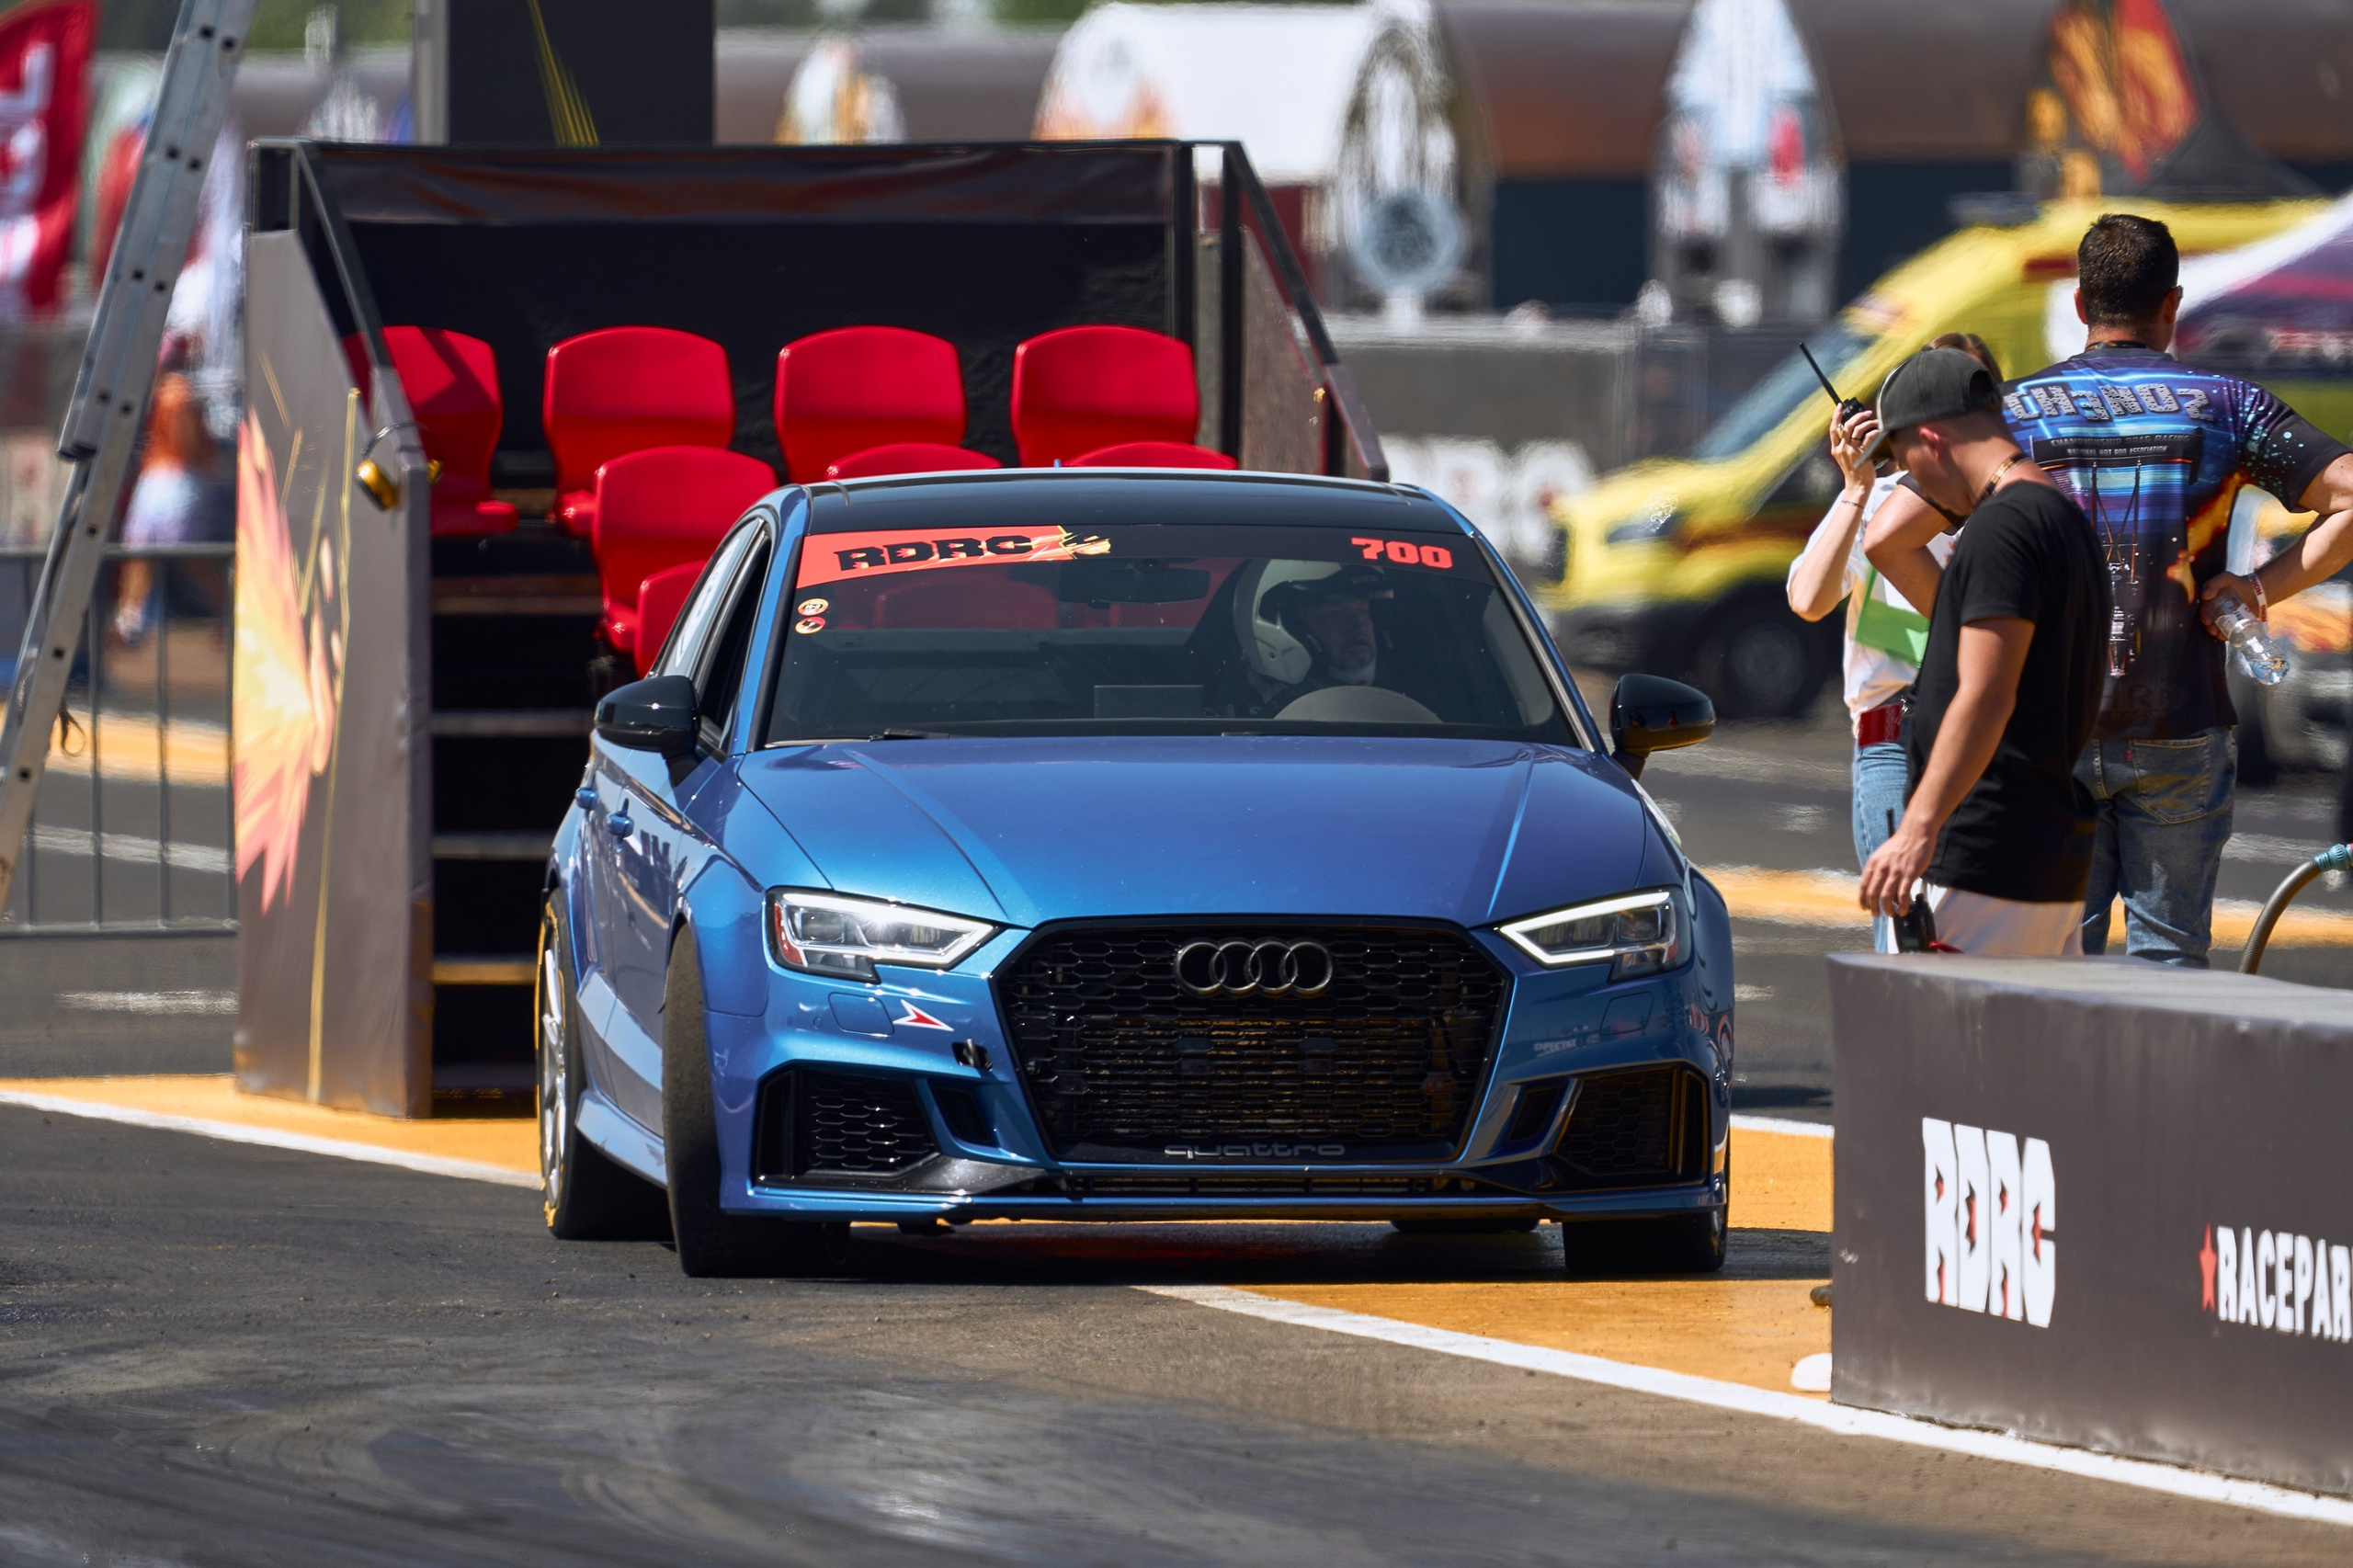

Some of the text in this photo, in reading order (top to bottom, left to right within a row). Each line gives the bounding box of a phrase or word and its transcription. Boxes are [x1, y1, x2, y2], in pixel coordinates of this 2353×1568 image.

[834, 535, 1033, 572] RDRC
[1351, 537, 1453, 569] 700
[1165, 1144, 1346, 1159] quattro
[1922, 1117, 2056, 1329] RDRC
[2217, 1225, 2353, 1344] RACEPAR
